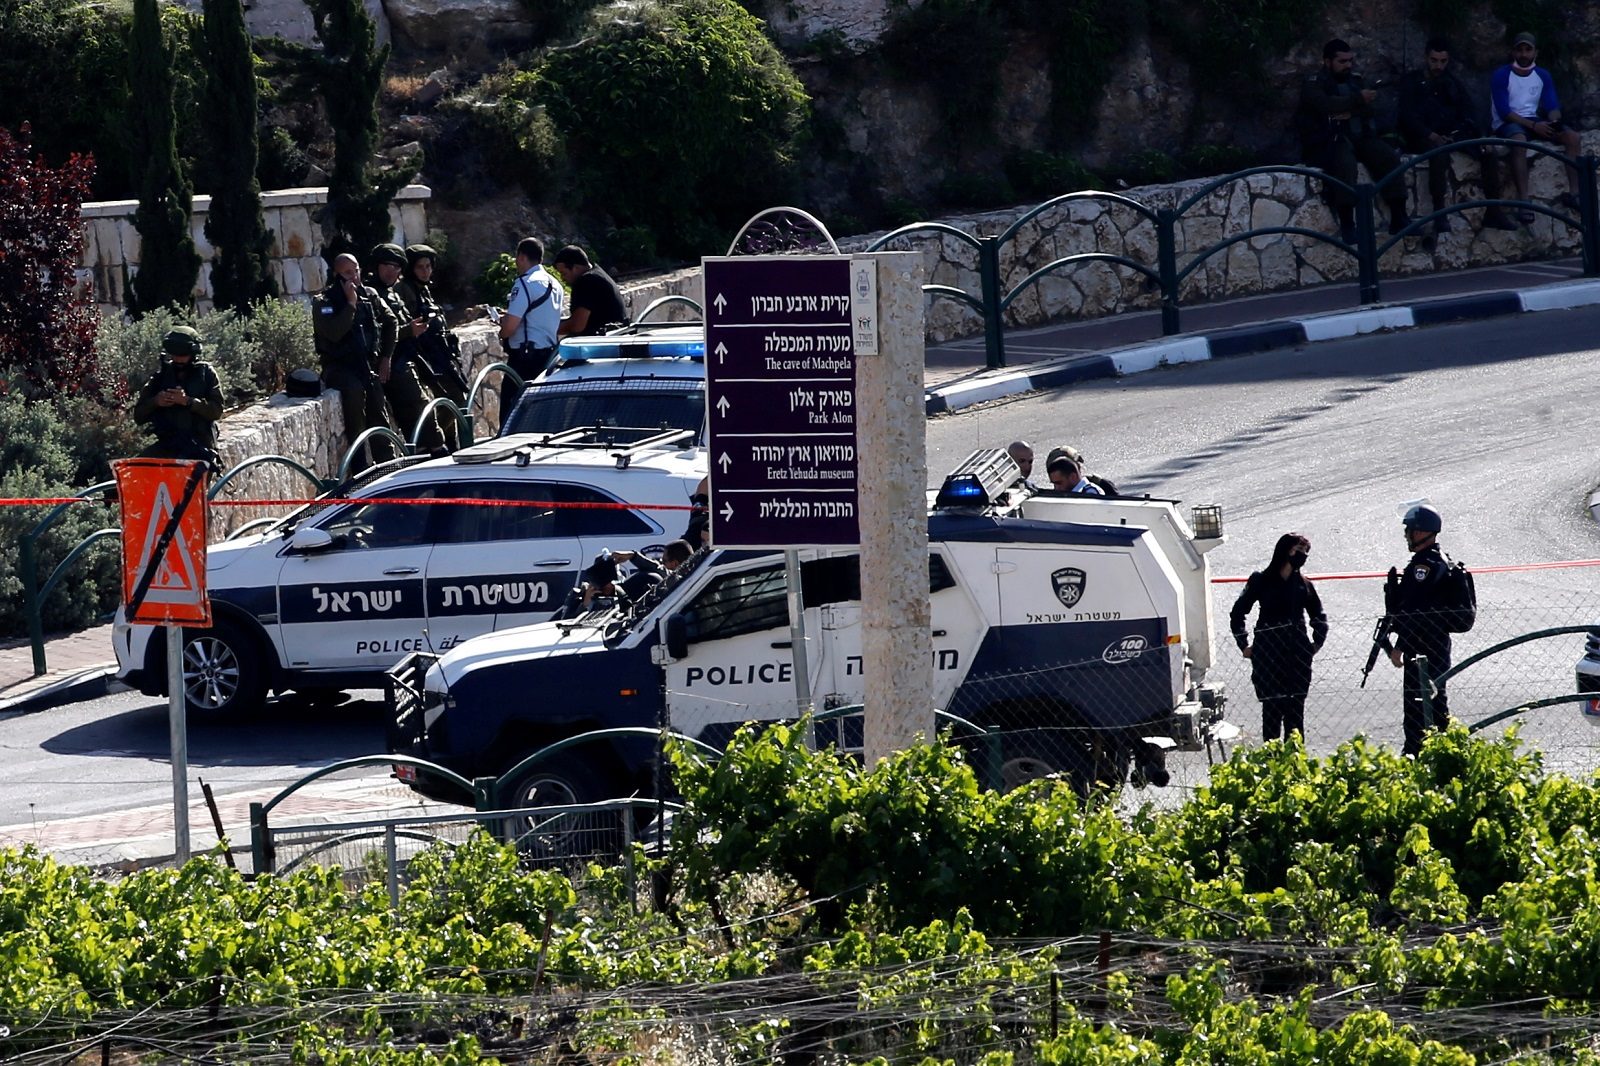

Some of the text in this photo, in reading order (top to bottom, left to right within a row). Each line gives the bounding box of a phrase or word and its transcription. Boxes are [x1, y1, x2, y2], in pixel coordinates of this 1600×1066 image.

[751, 295, 850, 317] קרית ארבע חברון
[764, 331, 850, 353] מערת המכפלה
[765, 356, 852, 373] The cave of Machpela
[789, 387, 852, 412] פארק אלון
[808, 411, 853, 424] Park Alon
[752, 445, 854, 466] מוזיאון ארץ יהודה
[767, 466, 855, 480] Eretz Yehuda museum
[759, 497, 853, 518] החברה הכלכלית
[312, 581, 549, 613] משטרת ישראל
[1026, 610, 1121, 624] משטרת ישראל
[356, 638, 423, 655] POLICE
[1120, 639, 1144, 650] 100
[686, 663, 792, 687] POLICE
